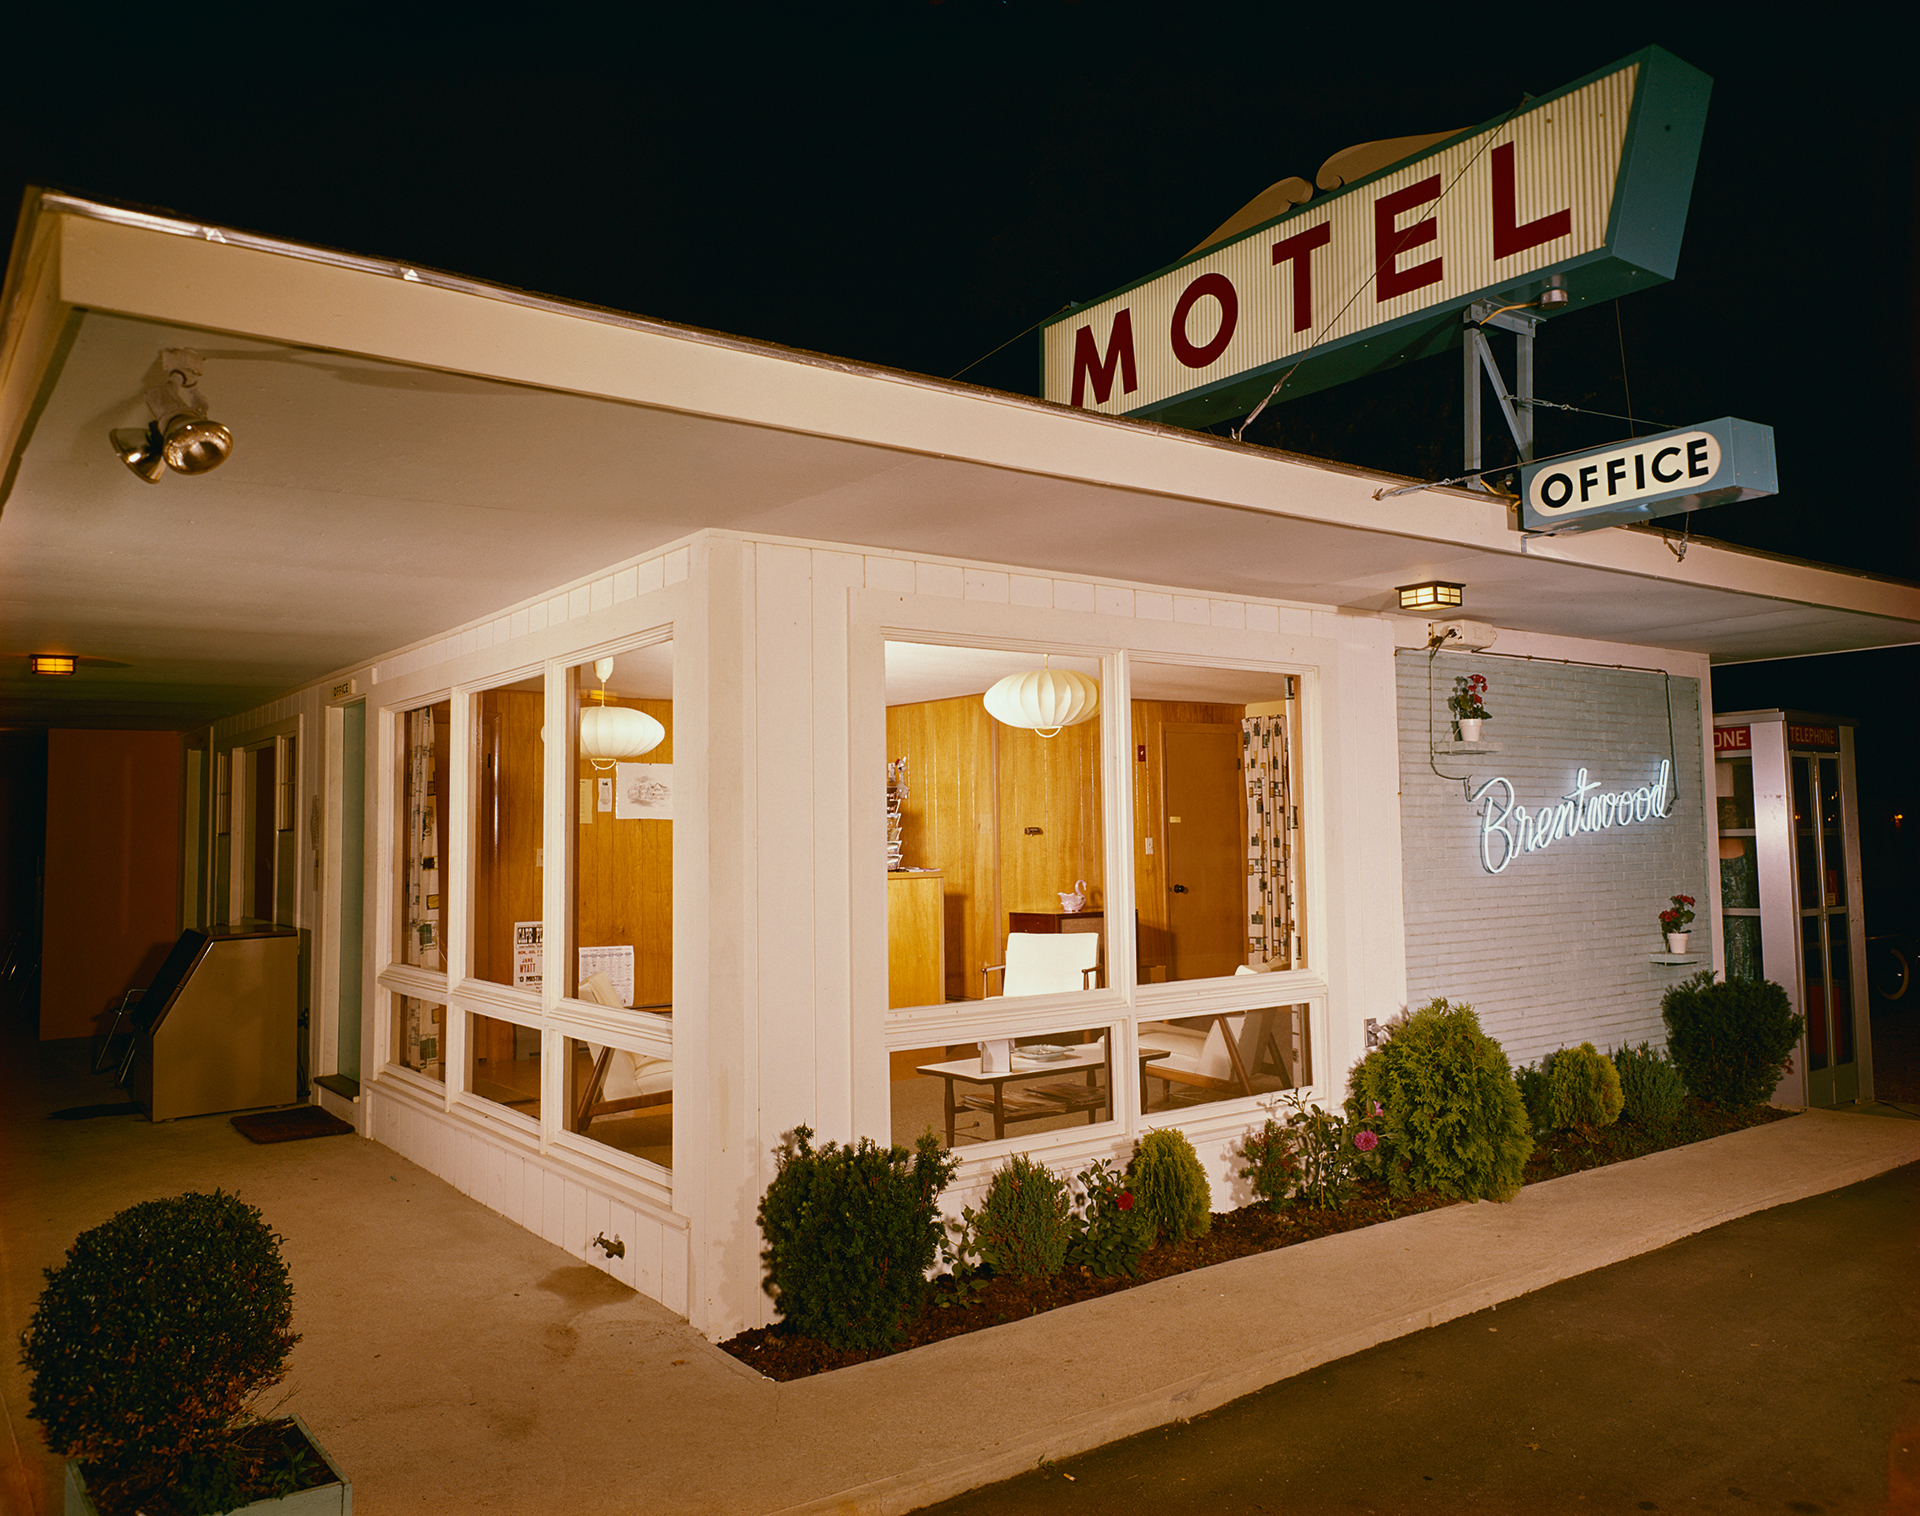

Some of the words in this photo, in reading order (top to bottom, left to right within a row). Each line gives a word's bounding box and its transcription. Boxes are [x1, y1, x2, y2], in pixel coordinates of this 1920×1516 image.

[1071, 141, 1571, 407] MOTEL
[1541, 438, 1709, 509] OFFICE
[333, 682, 349, 697] OFFICE
[1789, 726, 1835, 745] TELEPHONE
[1473, 759, 1671, 874] Brentwood
[518, 928, 533, 943] CAPE
[519, 963, 536, 973] WYATT
